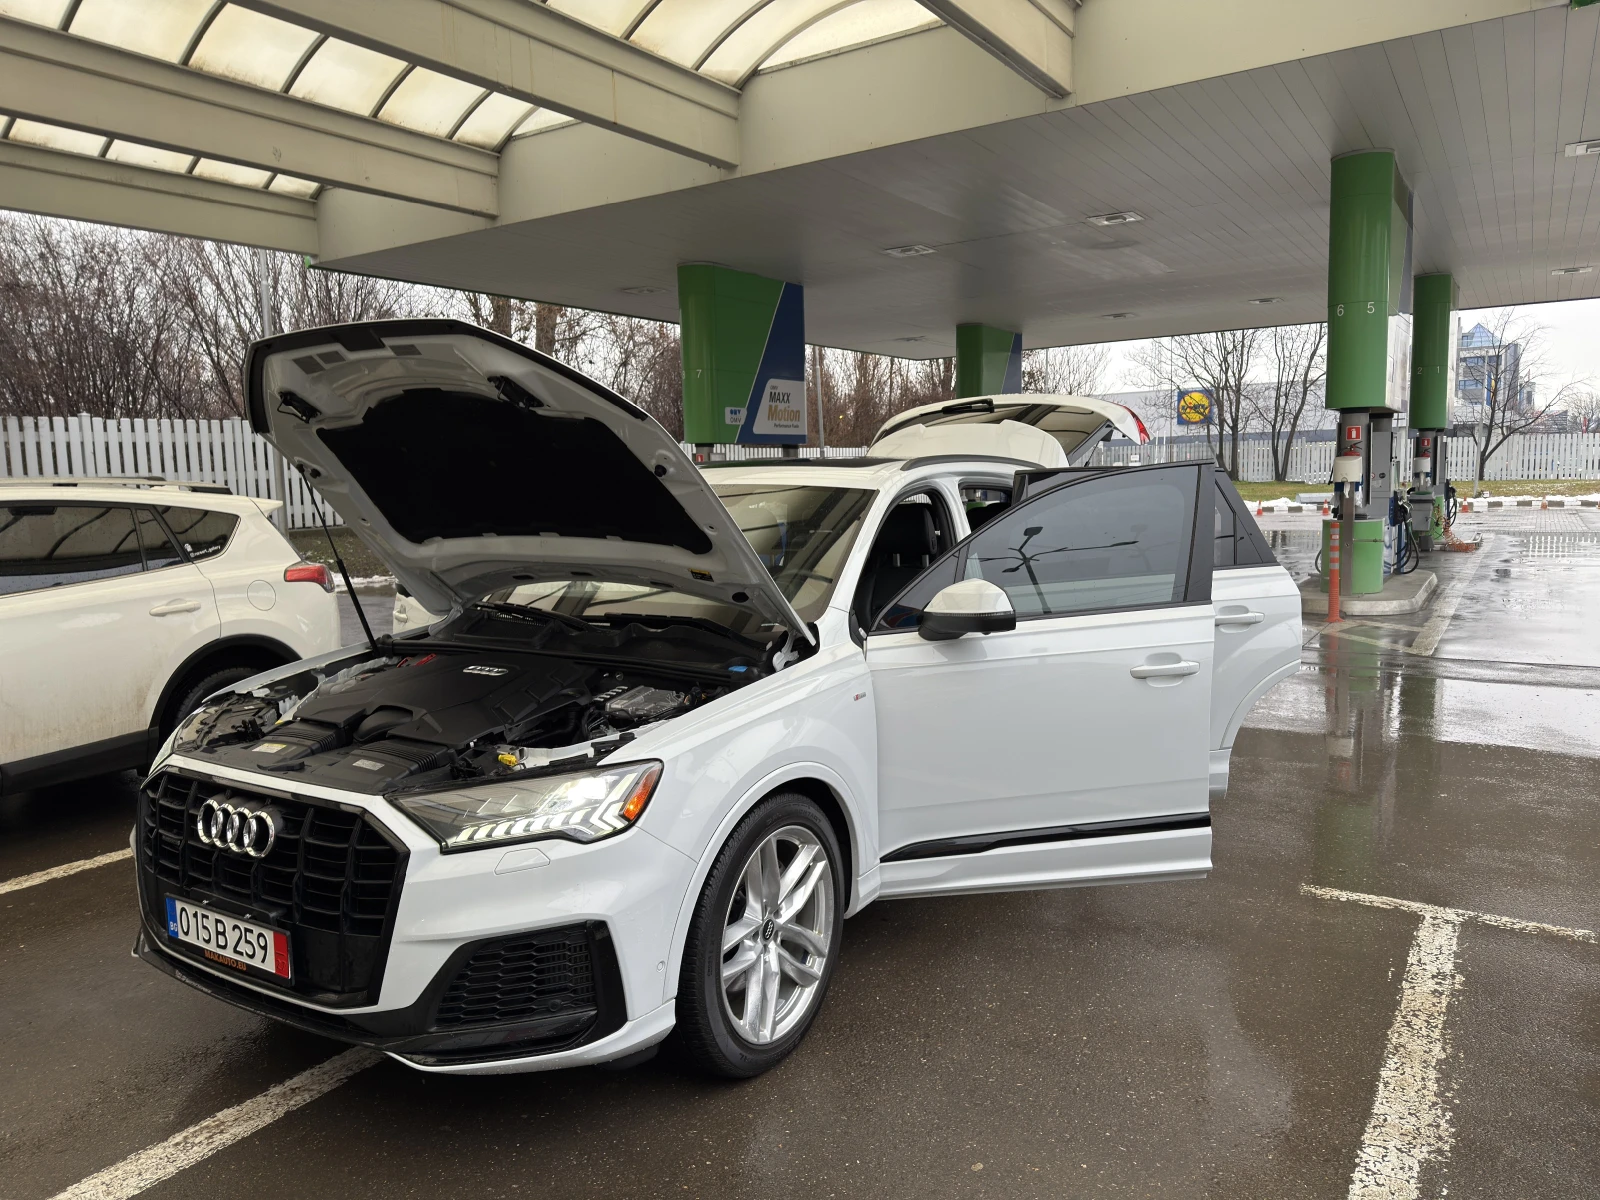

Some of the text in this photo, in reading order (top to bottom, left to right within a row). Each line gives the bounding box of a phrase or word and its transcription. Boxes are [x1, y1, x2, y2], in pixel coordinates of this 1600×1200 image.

[1337, 301, 1375, 316] 6 5
[696, 370, 701, 378] 7
[1417, 366, 1422, 374] 2
[769, 391, 791, 404] MAXX
[767, 405, 800, 421] Motion
[170, 922, 178, 931] BG
